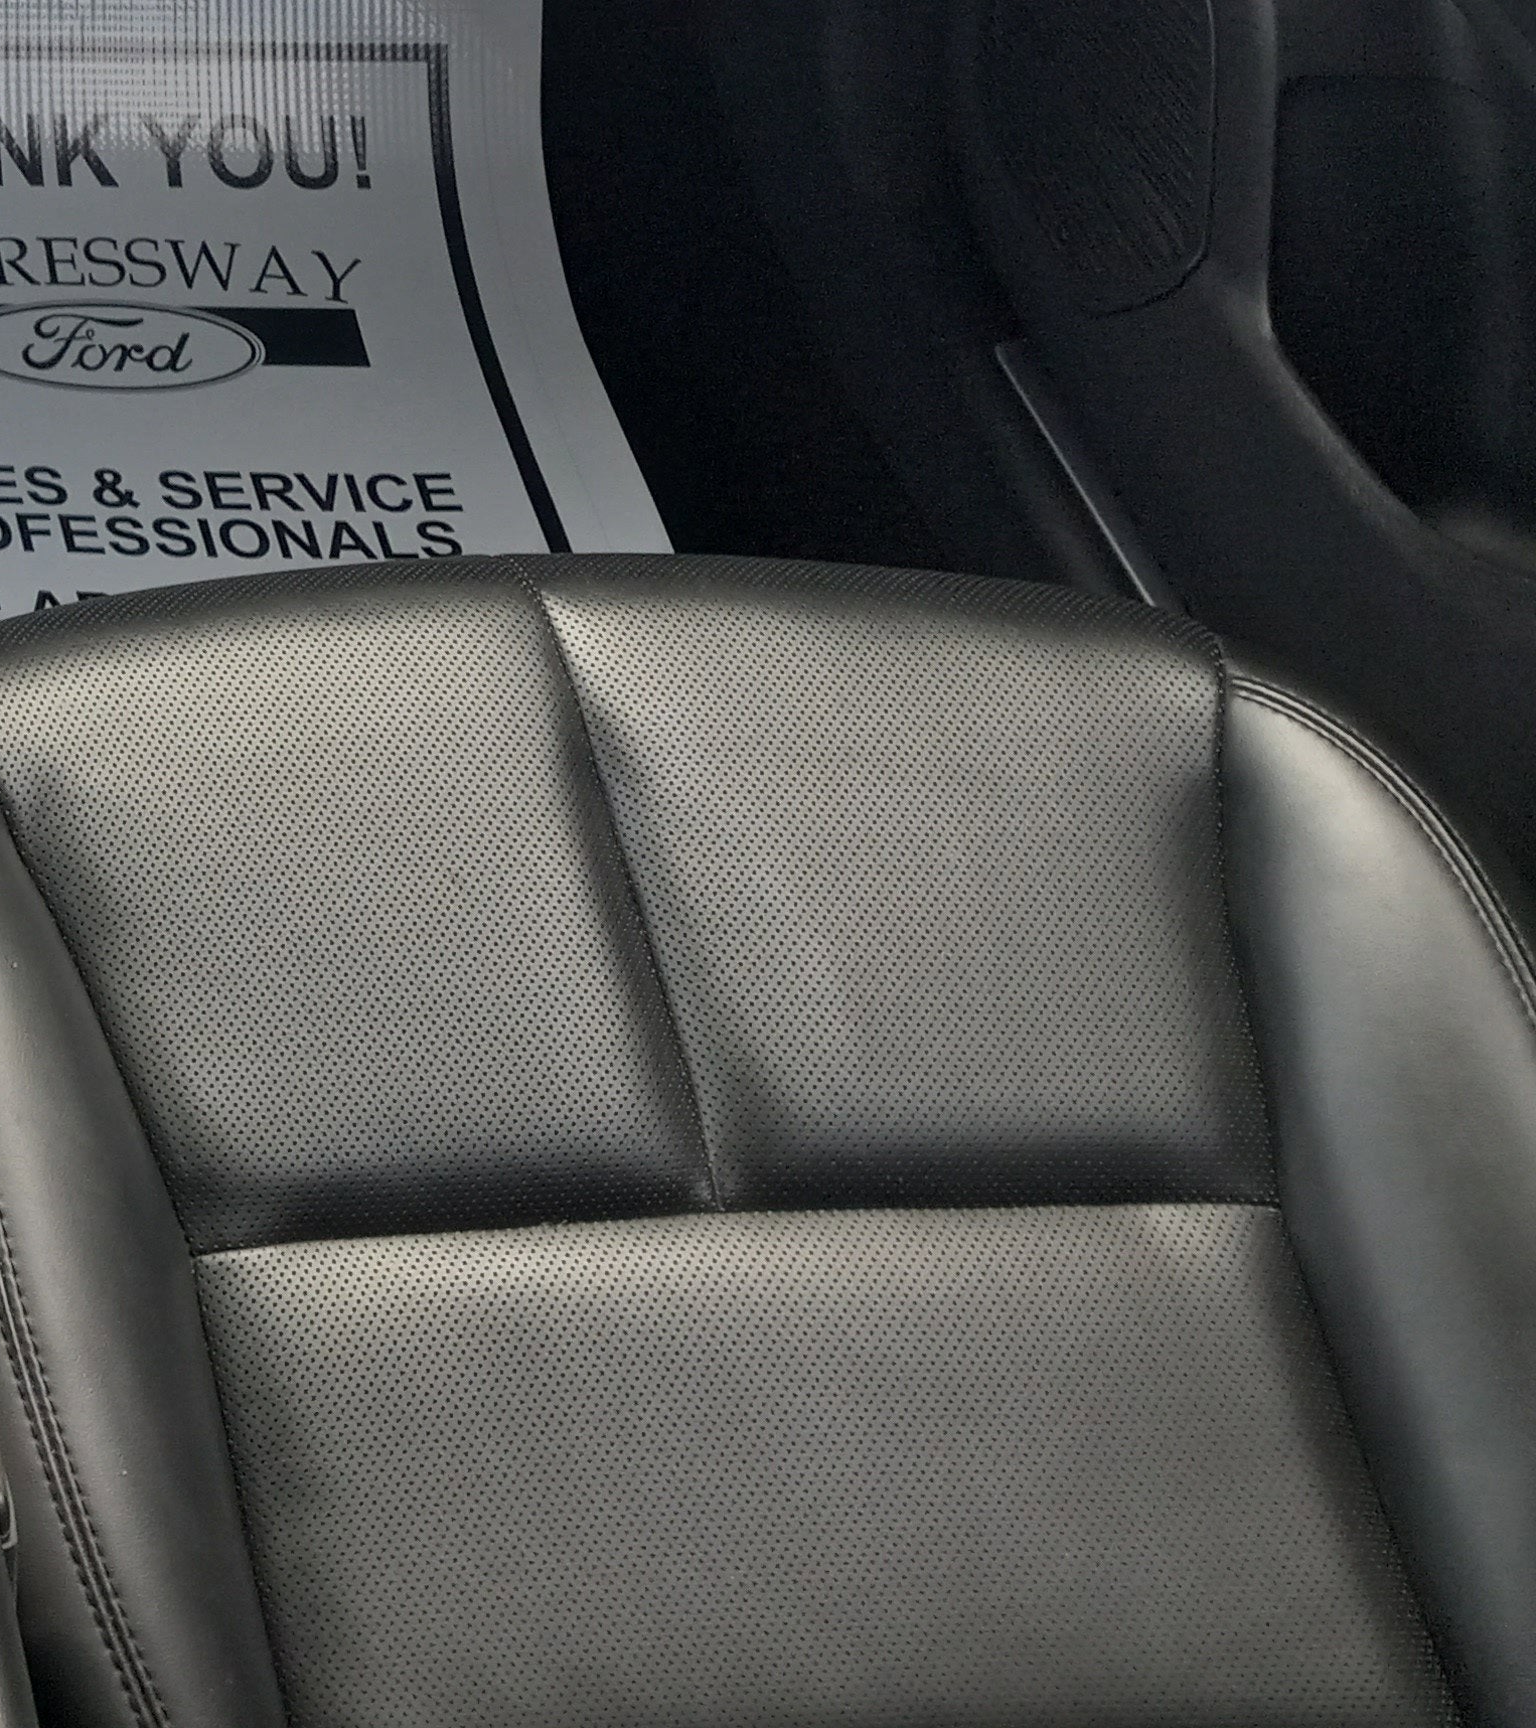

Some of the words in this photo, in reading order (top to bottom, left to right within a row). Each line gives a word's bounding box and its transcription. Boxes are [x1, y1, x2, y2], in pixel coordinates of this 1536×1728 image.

[138, 114, 374, 191] YOU!
[22, 313, 193, 373] Ford
[92, 467, 141, 510] &
[161, 469, 465, 515] SERVICE
